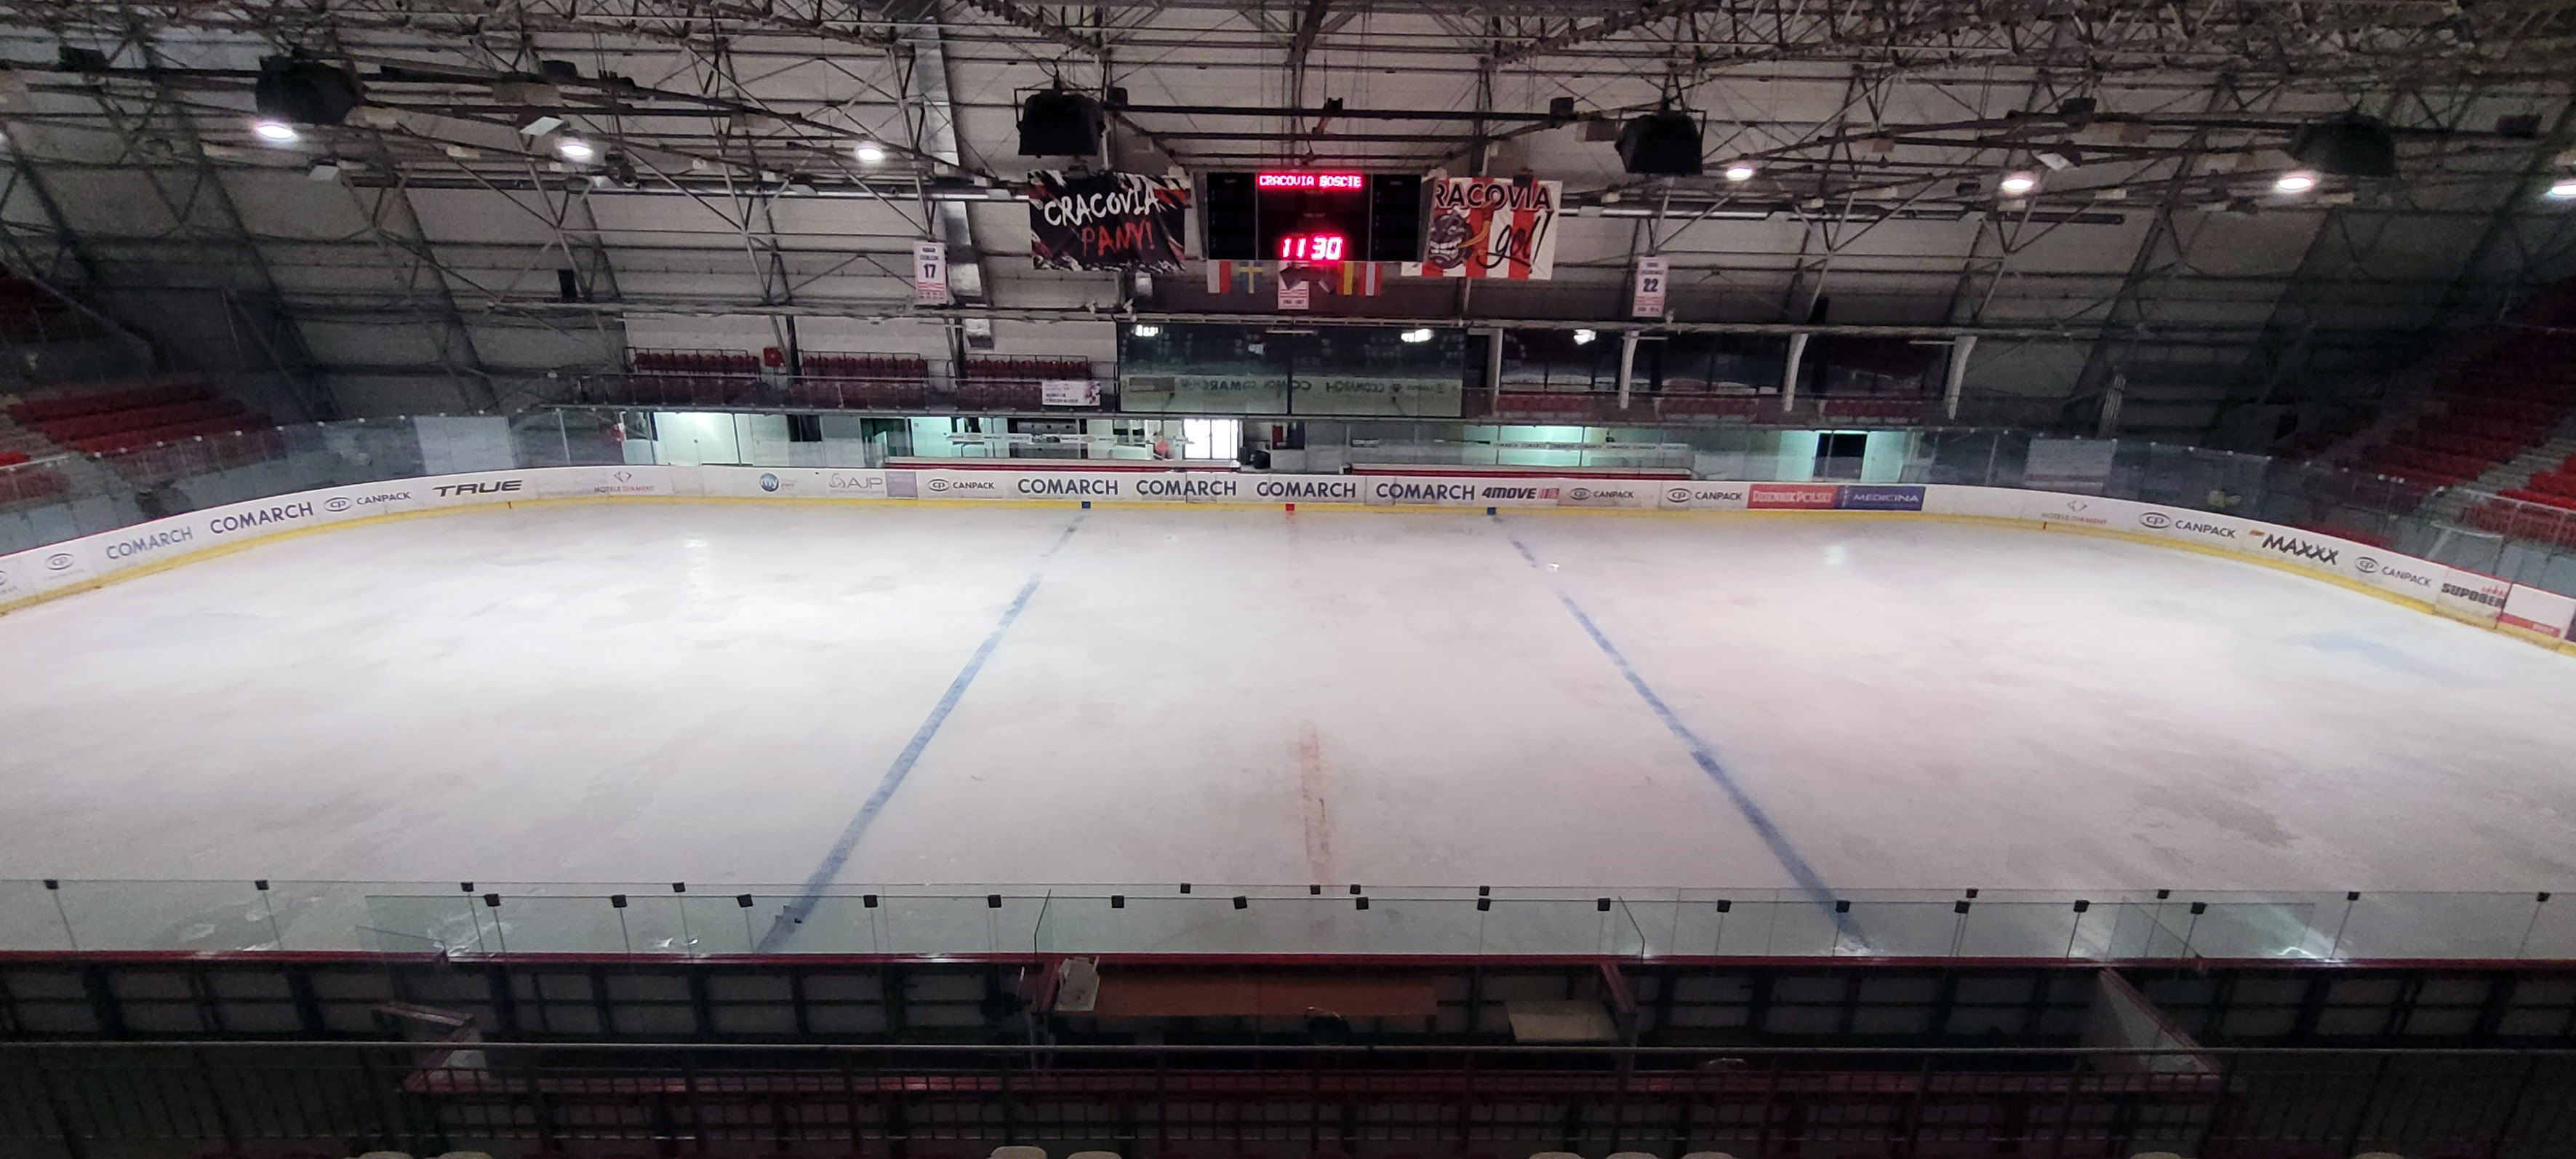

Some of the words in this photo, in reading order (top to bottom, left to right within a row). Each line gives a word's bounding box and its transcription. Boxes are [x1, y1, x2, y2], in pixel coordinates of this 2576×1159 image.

[1259, 175, 1314, 186] CRACOVIA
[1044, 186, 1162, 226] CRACOVIA
[1081, 219, 1156, 257] PANY!
[924, 264, 937, 278] 17
[1643, 278, 1658, 292] 22
[432, 480, 523, 498] TRUE
[847, 477, 883, 488] AJP
[953, 481, 994, 490] CANPACK
[1018, 478, 1119, 495] COMARCH
[1136, 479, 1237, 496] COMARCH
[1257, 481, 1356, 498] COMARCH
[356, 490, 411, 505] CANPACK
[1376, 482, 1475, 501] COMARCH
[1481, 487, 1537, 500] 4MOVE
[1593, 490, 1634, 499] CANPACK
[1695, 490, 1743, 501] CANPACK
[1854, 493, 1919, 502] MEDICINA
[210, 501, 314, 535] COMARCH
[2175, 520, 2236, 539] CANPACK
[106, 525, 193, 560] COMARCH
[2262, 533, 2340, 565] MAXXX
[2382, 566, 2433, 587] CANPACK
